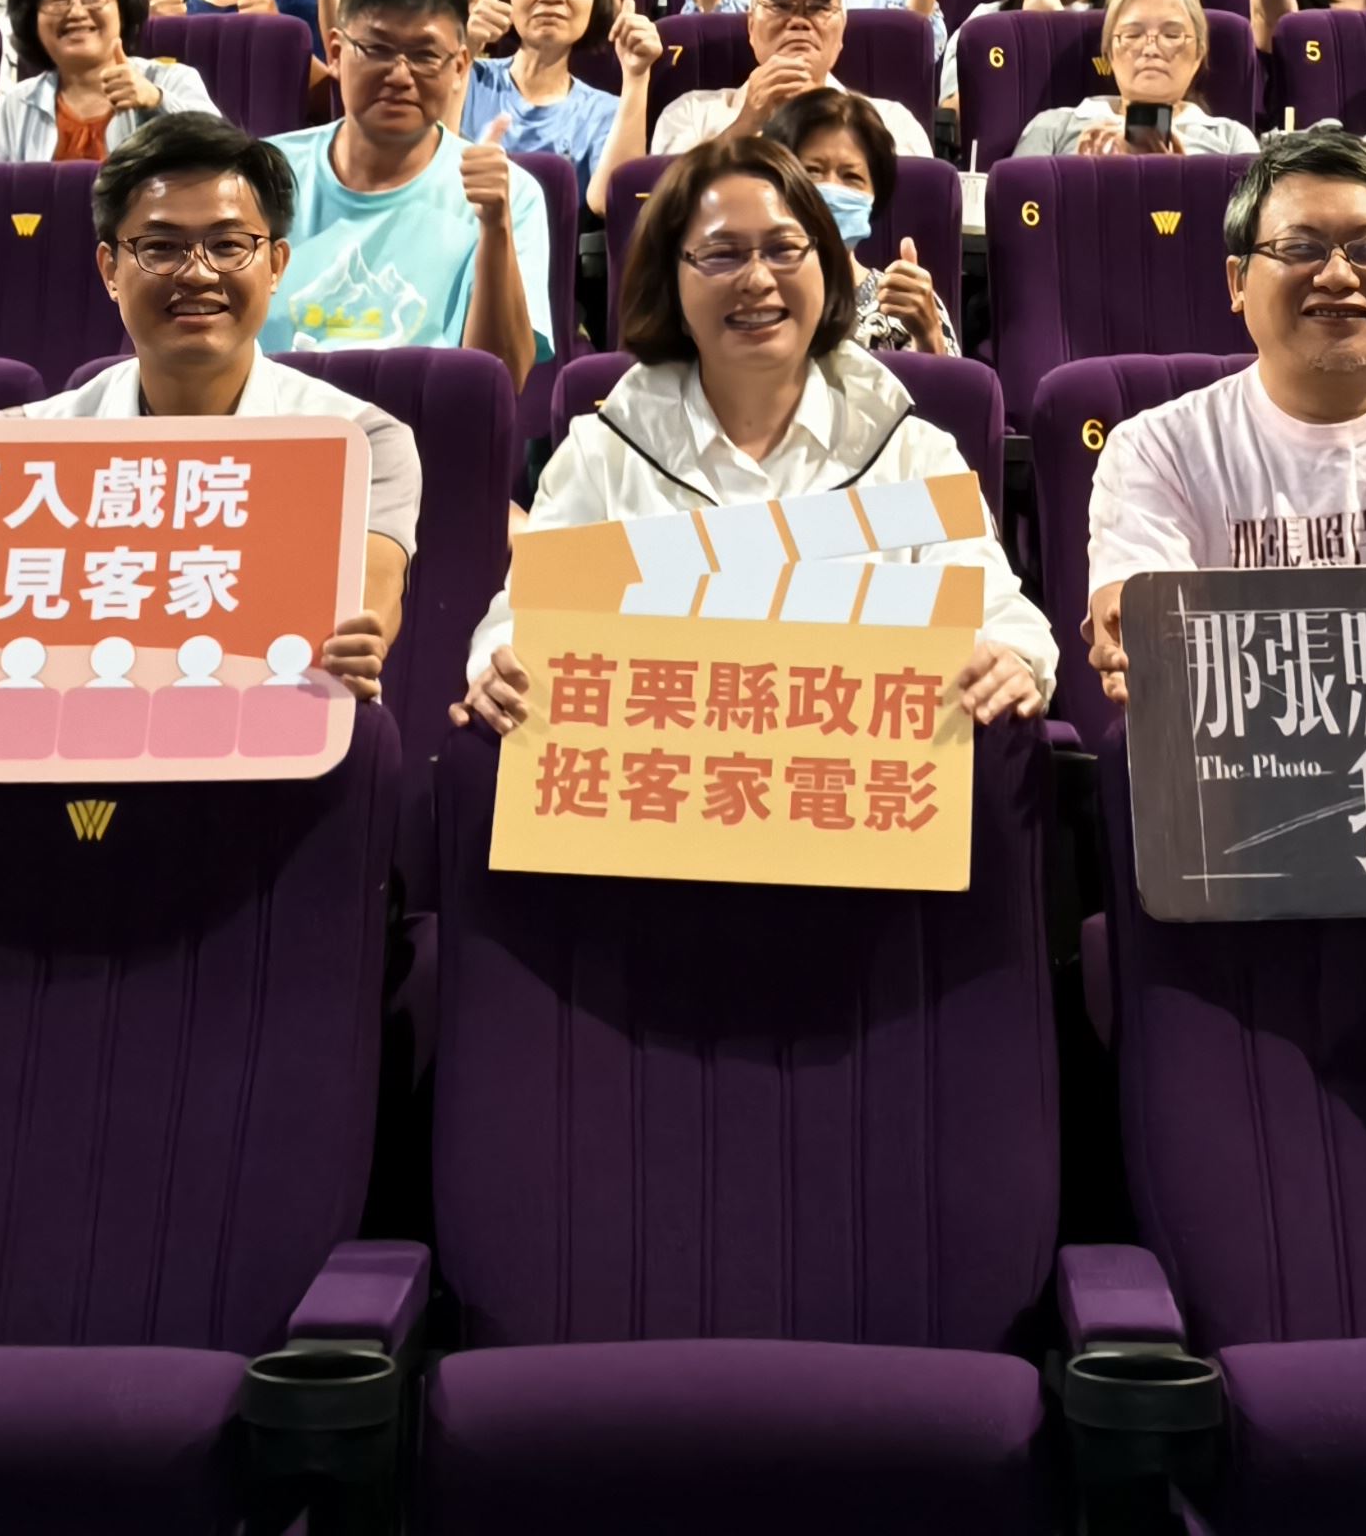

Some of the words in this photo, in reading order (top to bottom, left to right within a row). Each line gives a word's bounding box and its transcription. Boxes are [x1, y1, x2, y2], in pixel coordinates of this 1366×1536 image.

[668, 45, 683, 65] 7
[989, 47, 1004, 68] 6
[1306, 40, 1321, 62] 5
[1021, 201, 1040, 226] 6
[1082, 419, 1106, 453] 6
[547, 652, 944, 741] 苗栗縣政府
[1196, 755, 1244, 780] The
[1252, 753, 1322, 778] Photo
[535, 742, 940, 833] 挺客家電影
